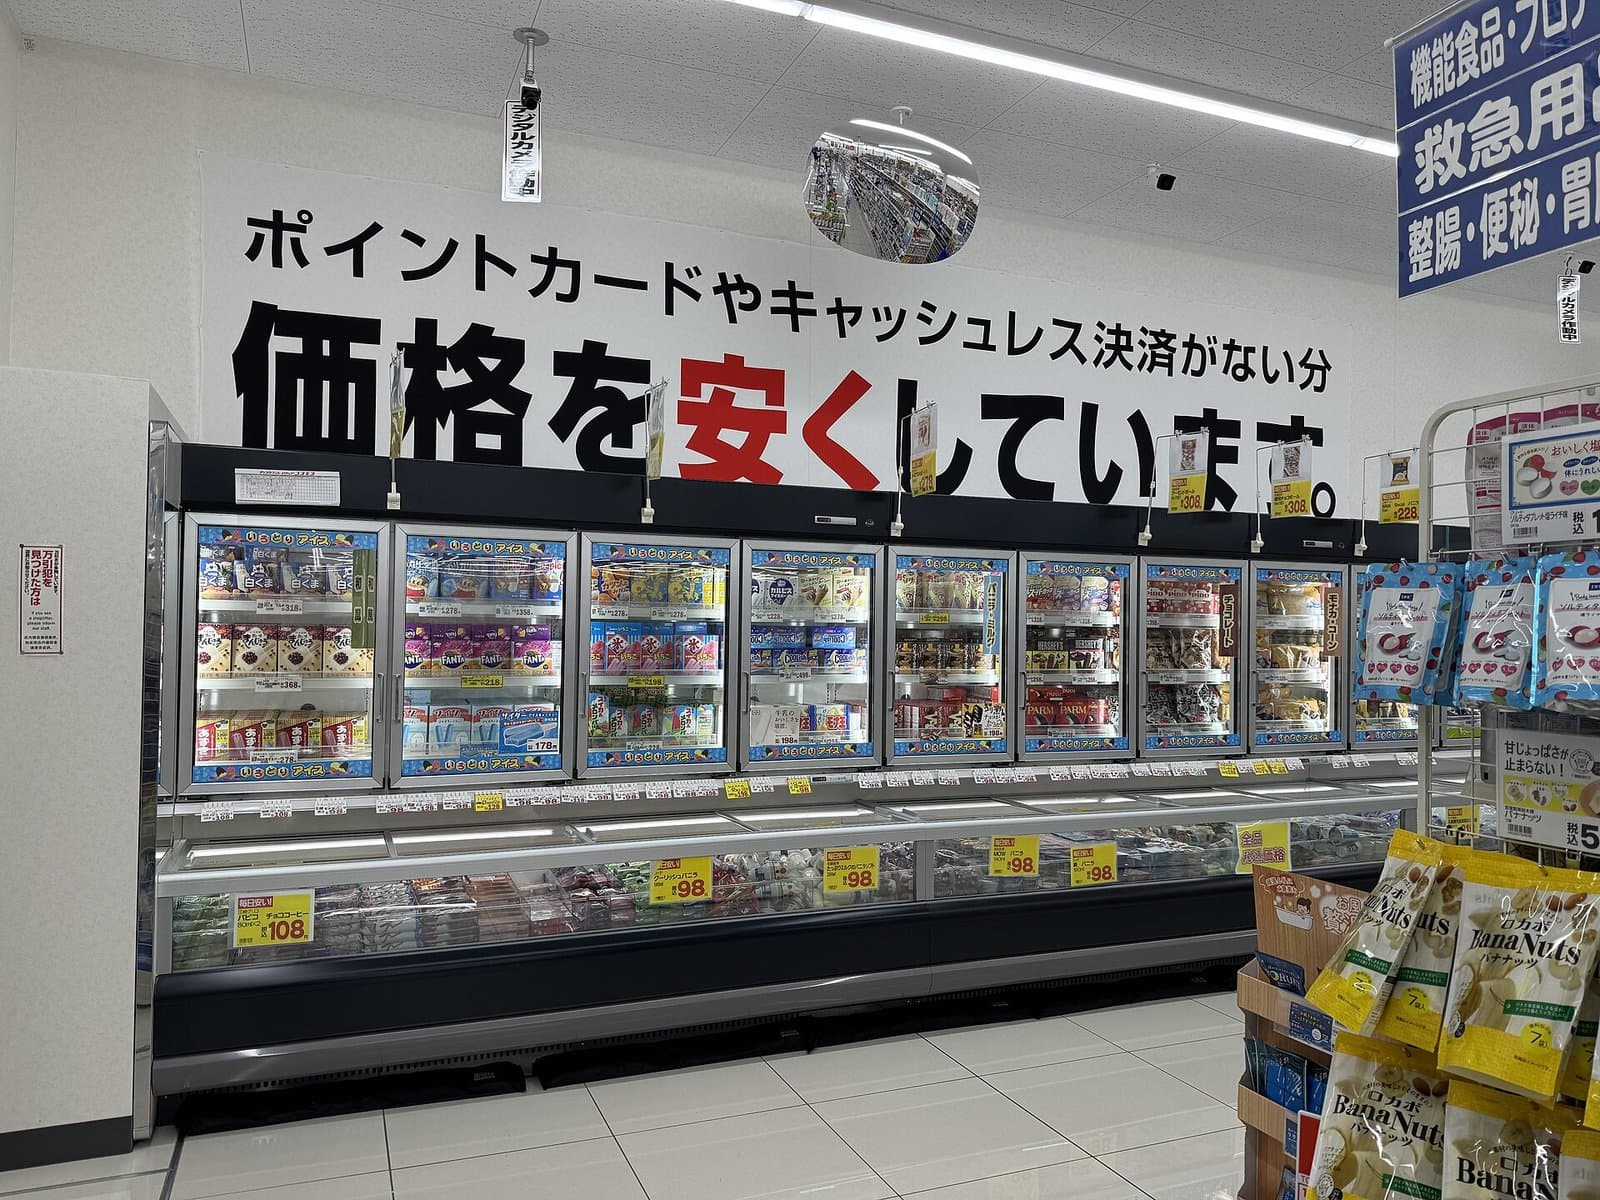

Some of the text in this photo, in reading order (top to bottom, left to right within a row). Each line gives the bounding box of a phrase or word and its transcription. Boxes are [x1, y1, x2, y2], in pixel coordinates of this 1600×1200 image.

[1414, 53, 1600, 194] 救急用
[1408, 151, 1600, 283] 整腸・便秘・胃
[244, 208, 1333, 394] ポイントカードやキャッシュレス決済がない分
[1288, 500, 1306, 513] 308
[1398, 507, 1417, 520] 228
[1573, 511, 1584, 535] 税込
[30, 550, 41, 606] 見つけた方は
[42, 550, 53, 588] 万引犯を
[244, 578, 273, 588] 白くま
[291, 579, 320, 589] 白くま
[1328, 594, 1339, 650] モナカ・コーン
[441, 655, 465, 665] FANTA
[523, 655, 545, 665] FANTA
[1028, 706, 1054, 714] PARM
[1060, 705, 1087, 714] PARM
[1504, 740, 1568, 760] 甘じょっぱさが
[1504, 757, 1564, 777] 止まらない!
[1504, 810, 1542, 823] バナナッツ
[1567, 822, 1578, 846] 税込
[1011, 857, 1034, 873] 98
[1091, 865, 1112, 881] 98
[678, 879, 705, 898] 98
[848, 870, 873, 888] 98
[1469, 928, 1582, 967] BanaNuts
[1480, 952, 1540, 971] バナナッツ
[1369, 1090, 1423, 1113] ロカボ
